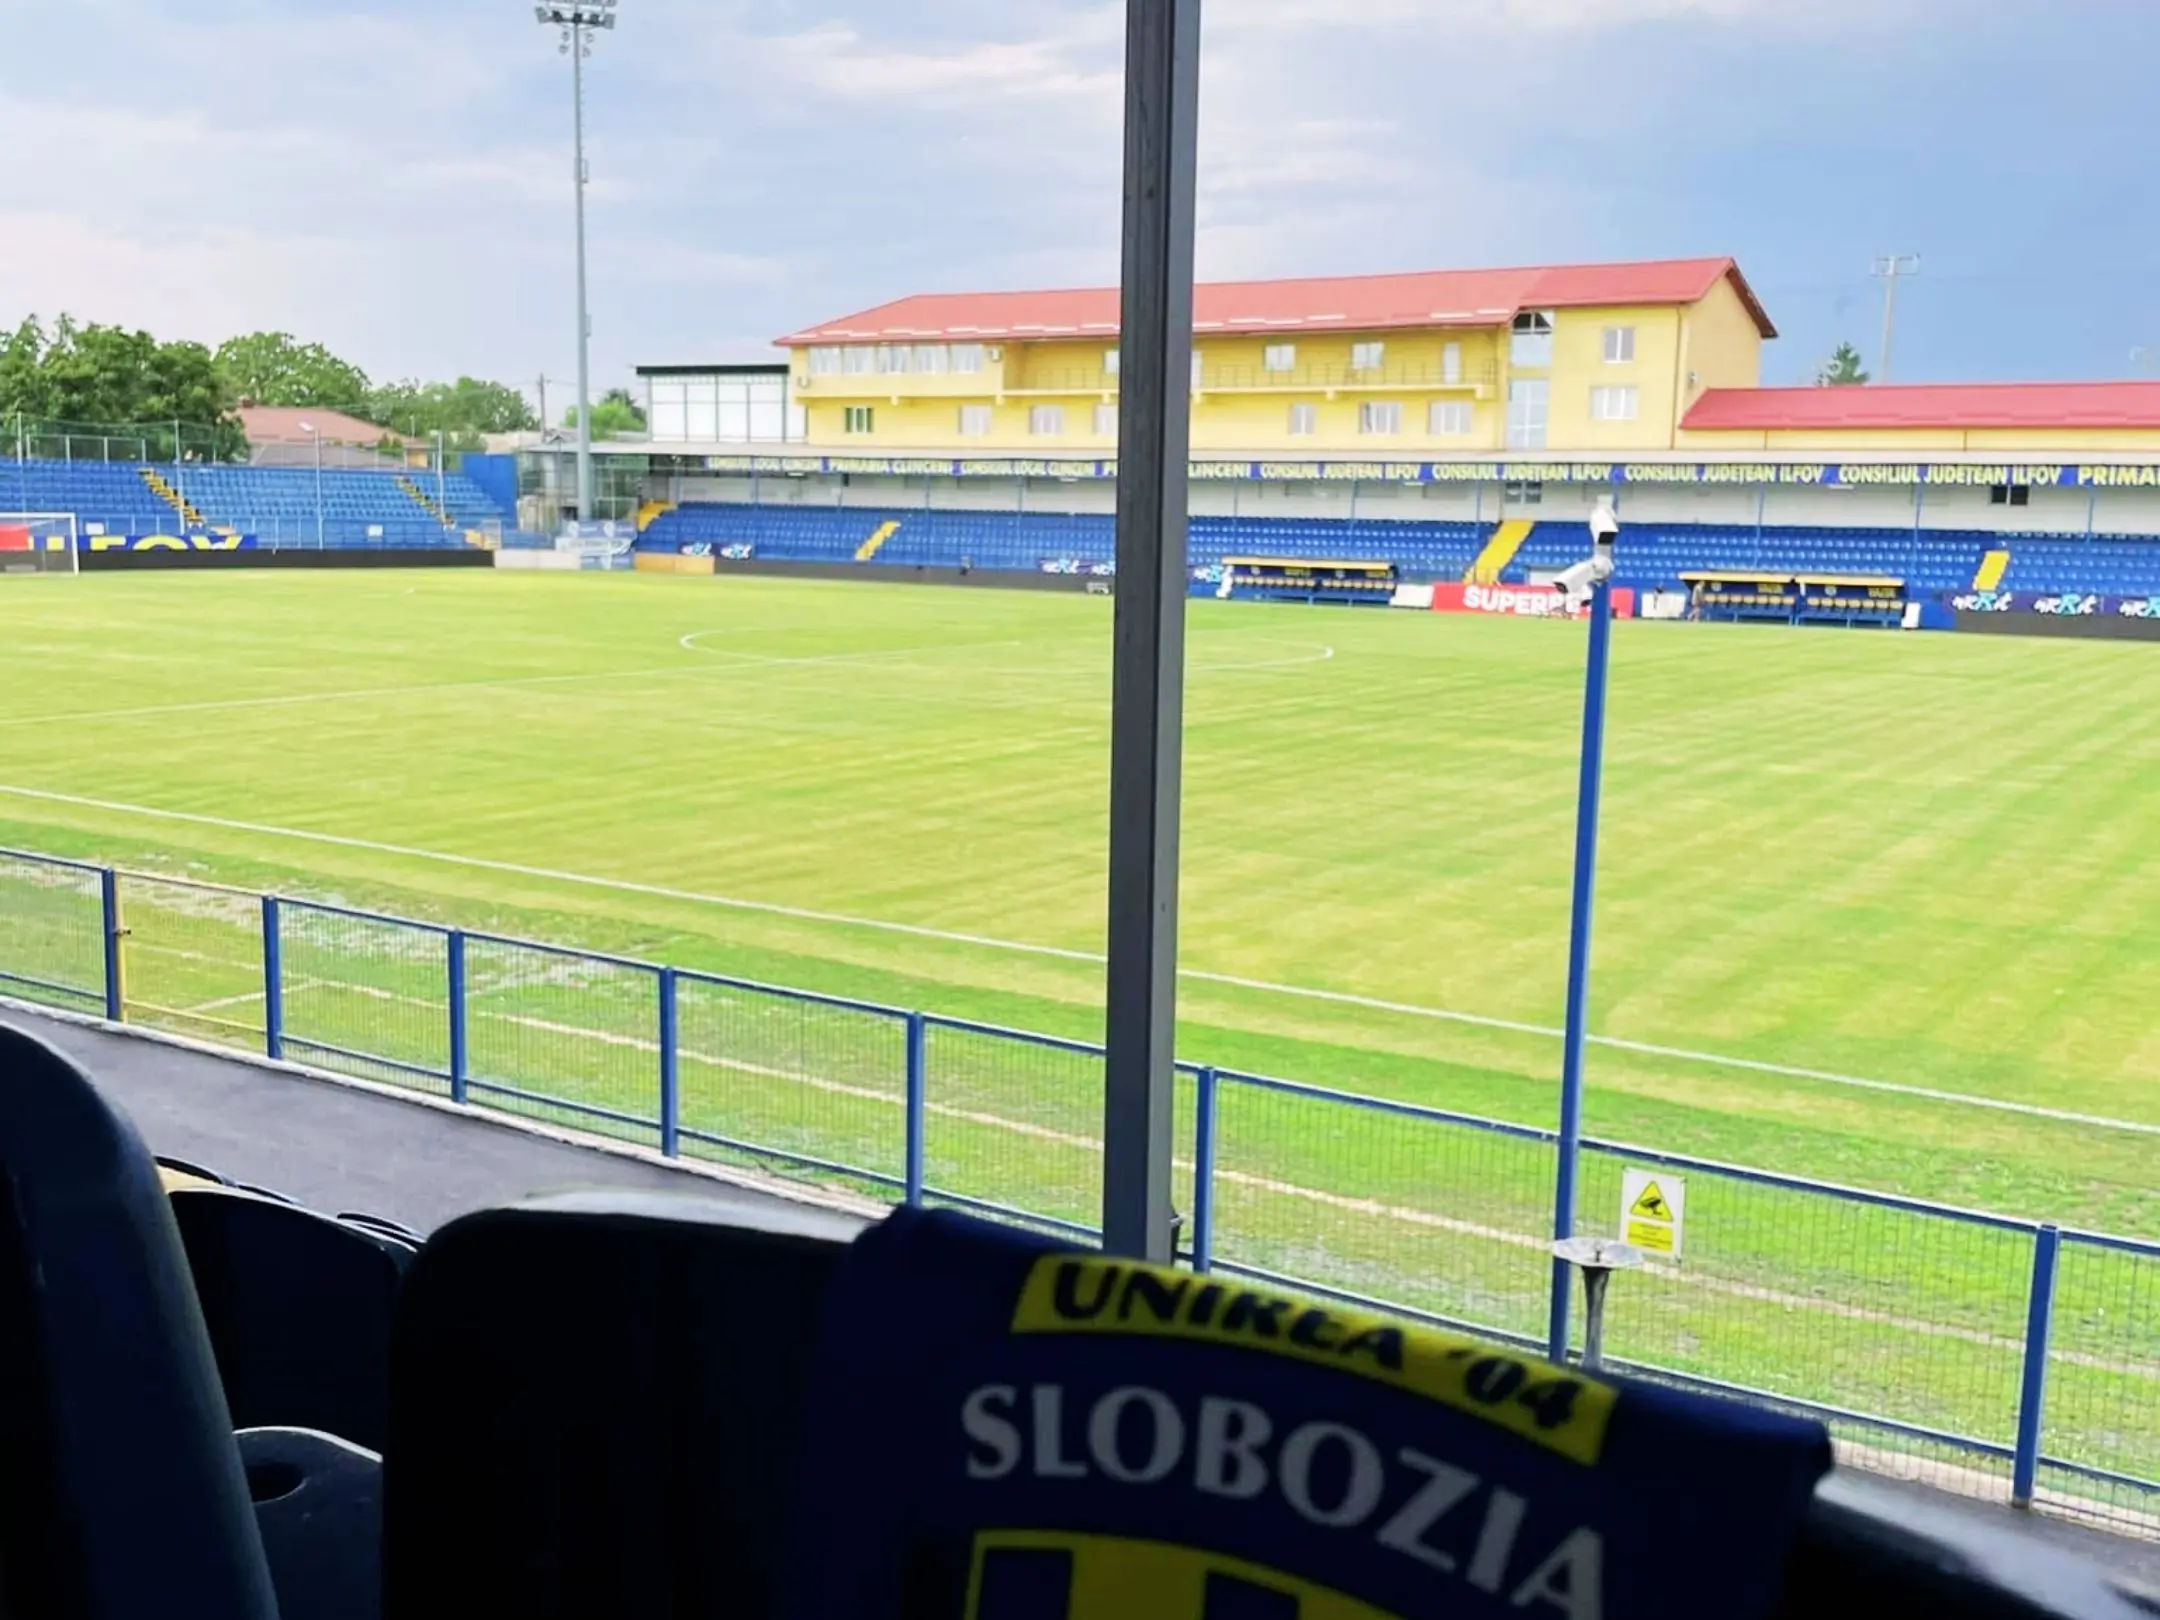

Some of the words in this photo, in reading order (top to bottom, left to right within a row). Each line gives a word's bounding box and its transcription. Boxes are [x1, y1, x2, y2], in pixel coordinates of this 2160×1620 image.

[1188, 462, 1250, 478] LINCENI
[1432, 463, 1499, 480] CONSILIUL
[1571, 464, 1611, 481] ILFOV
[1624, 463, 1699, 481] CONSILIUL
[1779, 464, 1824, 483] ILFOV
[1838, 465, 1921, 484] CONSILIUL
[2011, 466, 2063, 486] ILFOV
[2077, 466, 2160, 486] PRIMA
[1463, 585, 1592, 615] SUPERBE
[1052, 1261, 1404, 1371] UNIREA
[960, 1384, 1605, 1620] SLOBOZIA
